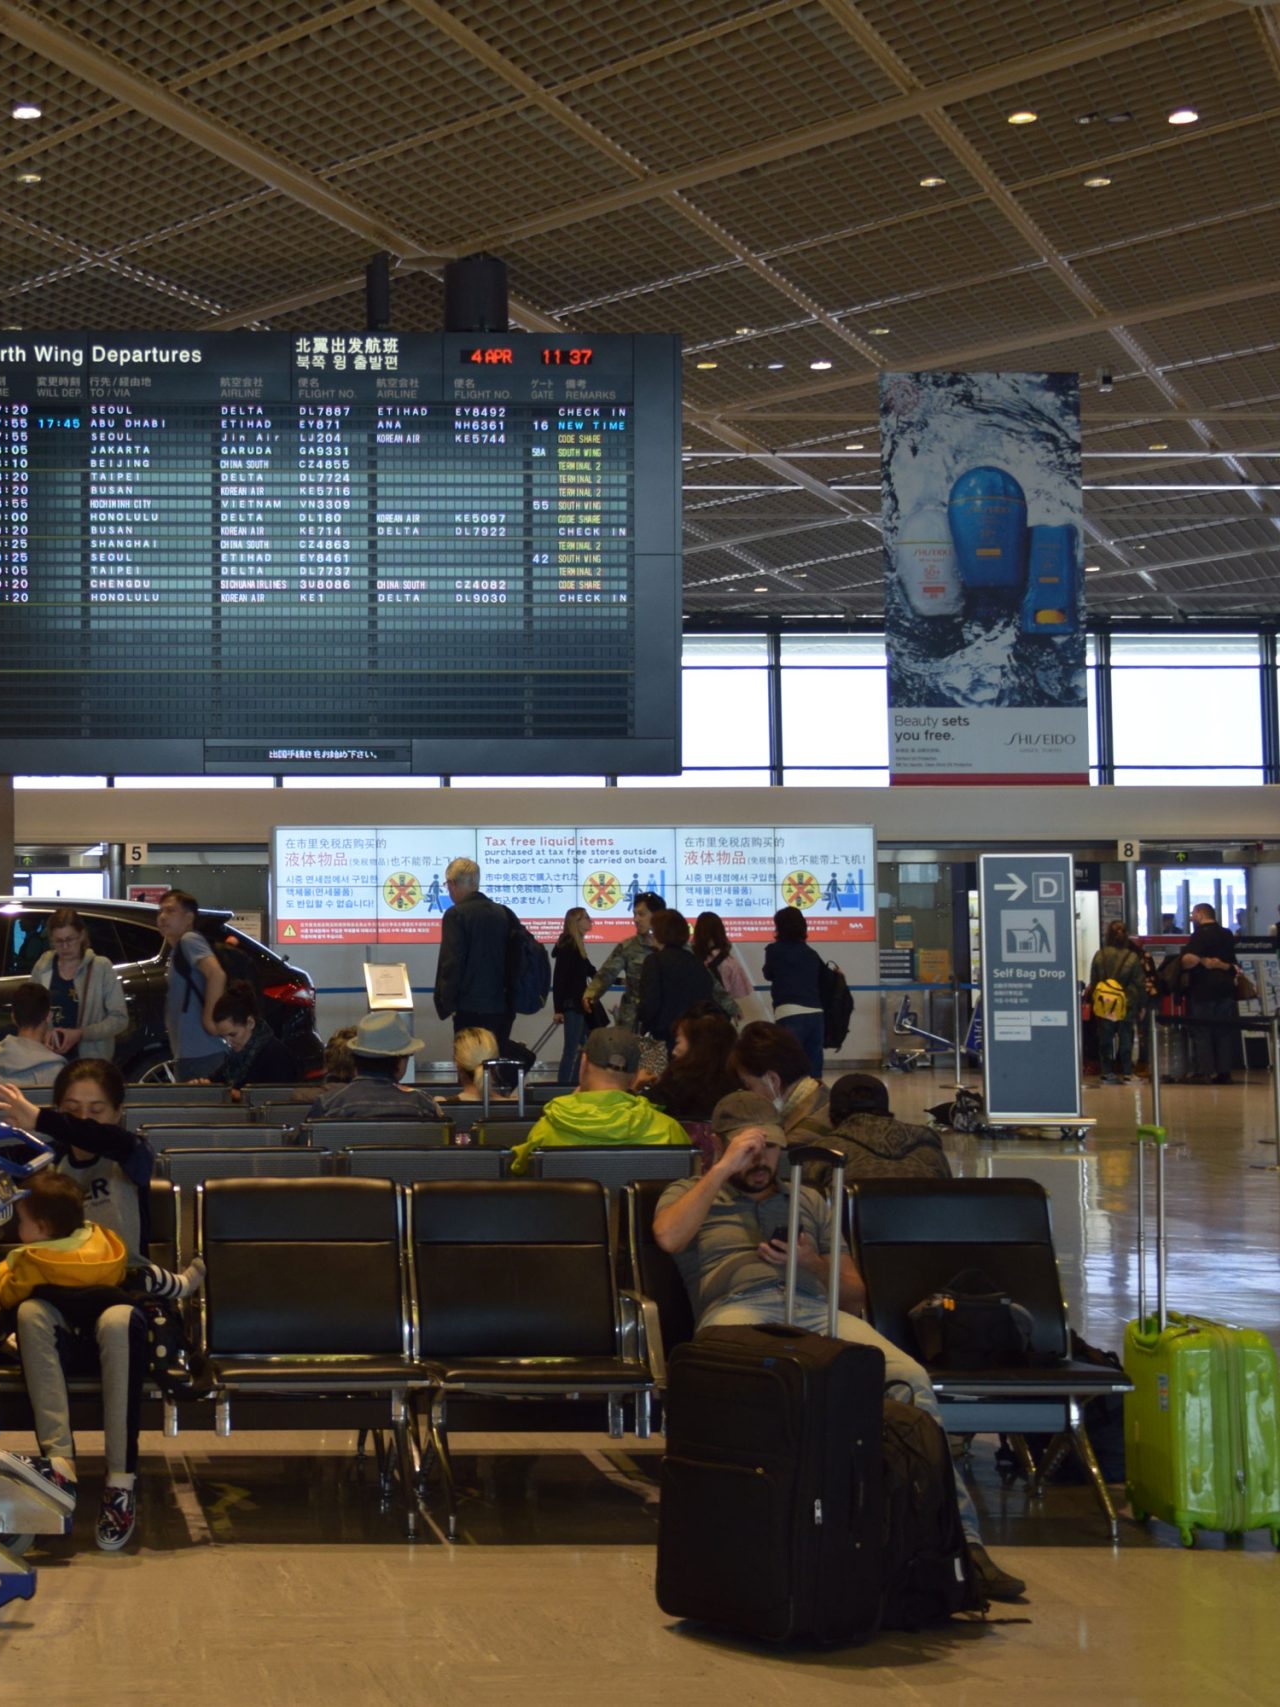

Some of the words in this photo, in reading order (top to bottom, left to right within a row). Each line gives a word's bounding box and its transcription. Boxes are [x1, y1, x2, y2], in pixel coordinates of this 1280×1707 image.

[34, 346, 84, 366] Wing
[92, 346, 201, 365] Departures
[297, 355, 325, 369] 북쪽
[354, 355, 397, 370] 출발편
[92, 406, 131, 414] SEOUL
[222, 406, 263, 415] DELTA
[300, 407, 349, 416] DL7887
[378, 407, 427, 415] ETIHAD
[456, 408, 505, 417] EY8492
[559, 408, 599, 416] CHECK
[612, 408, 625, 416] IN
[39, 419, 80, 428] 17:45
[91, 419, 114, 427] ABU
[125, 419, 164, 428] DHABI
[221, 420, 271, 428] ETIHAD
[300, 420, 339, 429] EY871
[455, 421, 503, 430] NH6361
[534, 421, 548, 430] 16
[593, 422, 624, 430] TIME
[91, 593, 159, 601] HONOLULU
[378, 594, 419, 602] DELTA
[456, 594, 506, 602] DL9030
[895, 716, 938, 728] Beauty
[942, 716, 969, 726] sets
[895, 731, 919, 743] you
[925, 730, 954, 741] free.
[1005, 733, 1076, 745] SHISEIDO
[131, 846, 141, 861] 5
[1124, 843, 1134, 857] 8
[1039, 878, 1058, 897] D
[993, 968, 1013, 977] Self
[1016, 969, 1036, 980] Bag
[1039, 969, 1065, 979] Drop
